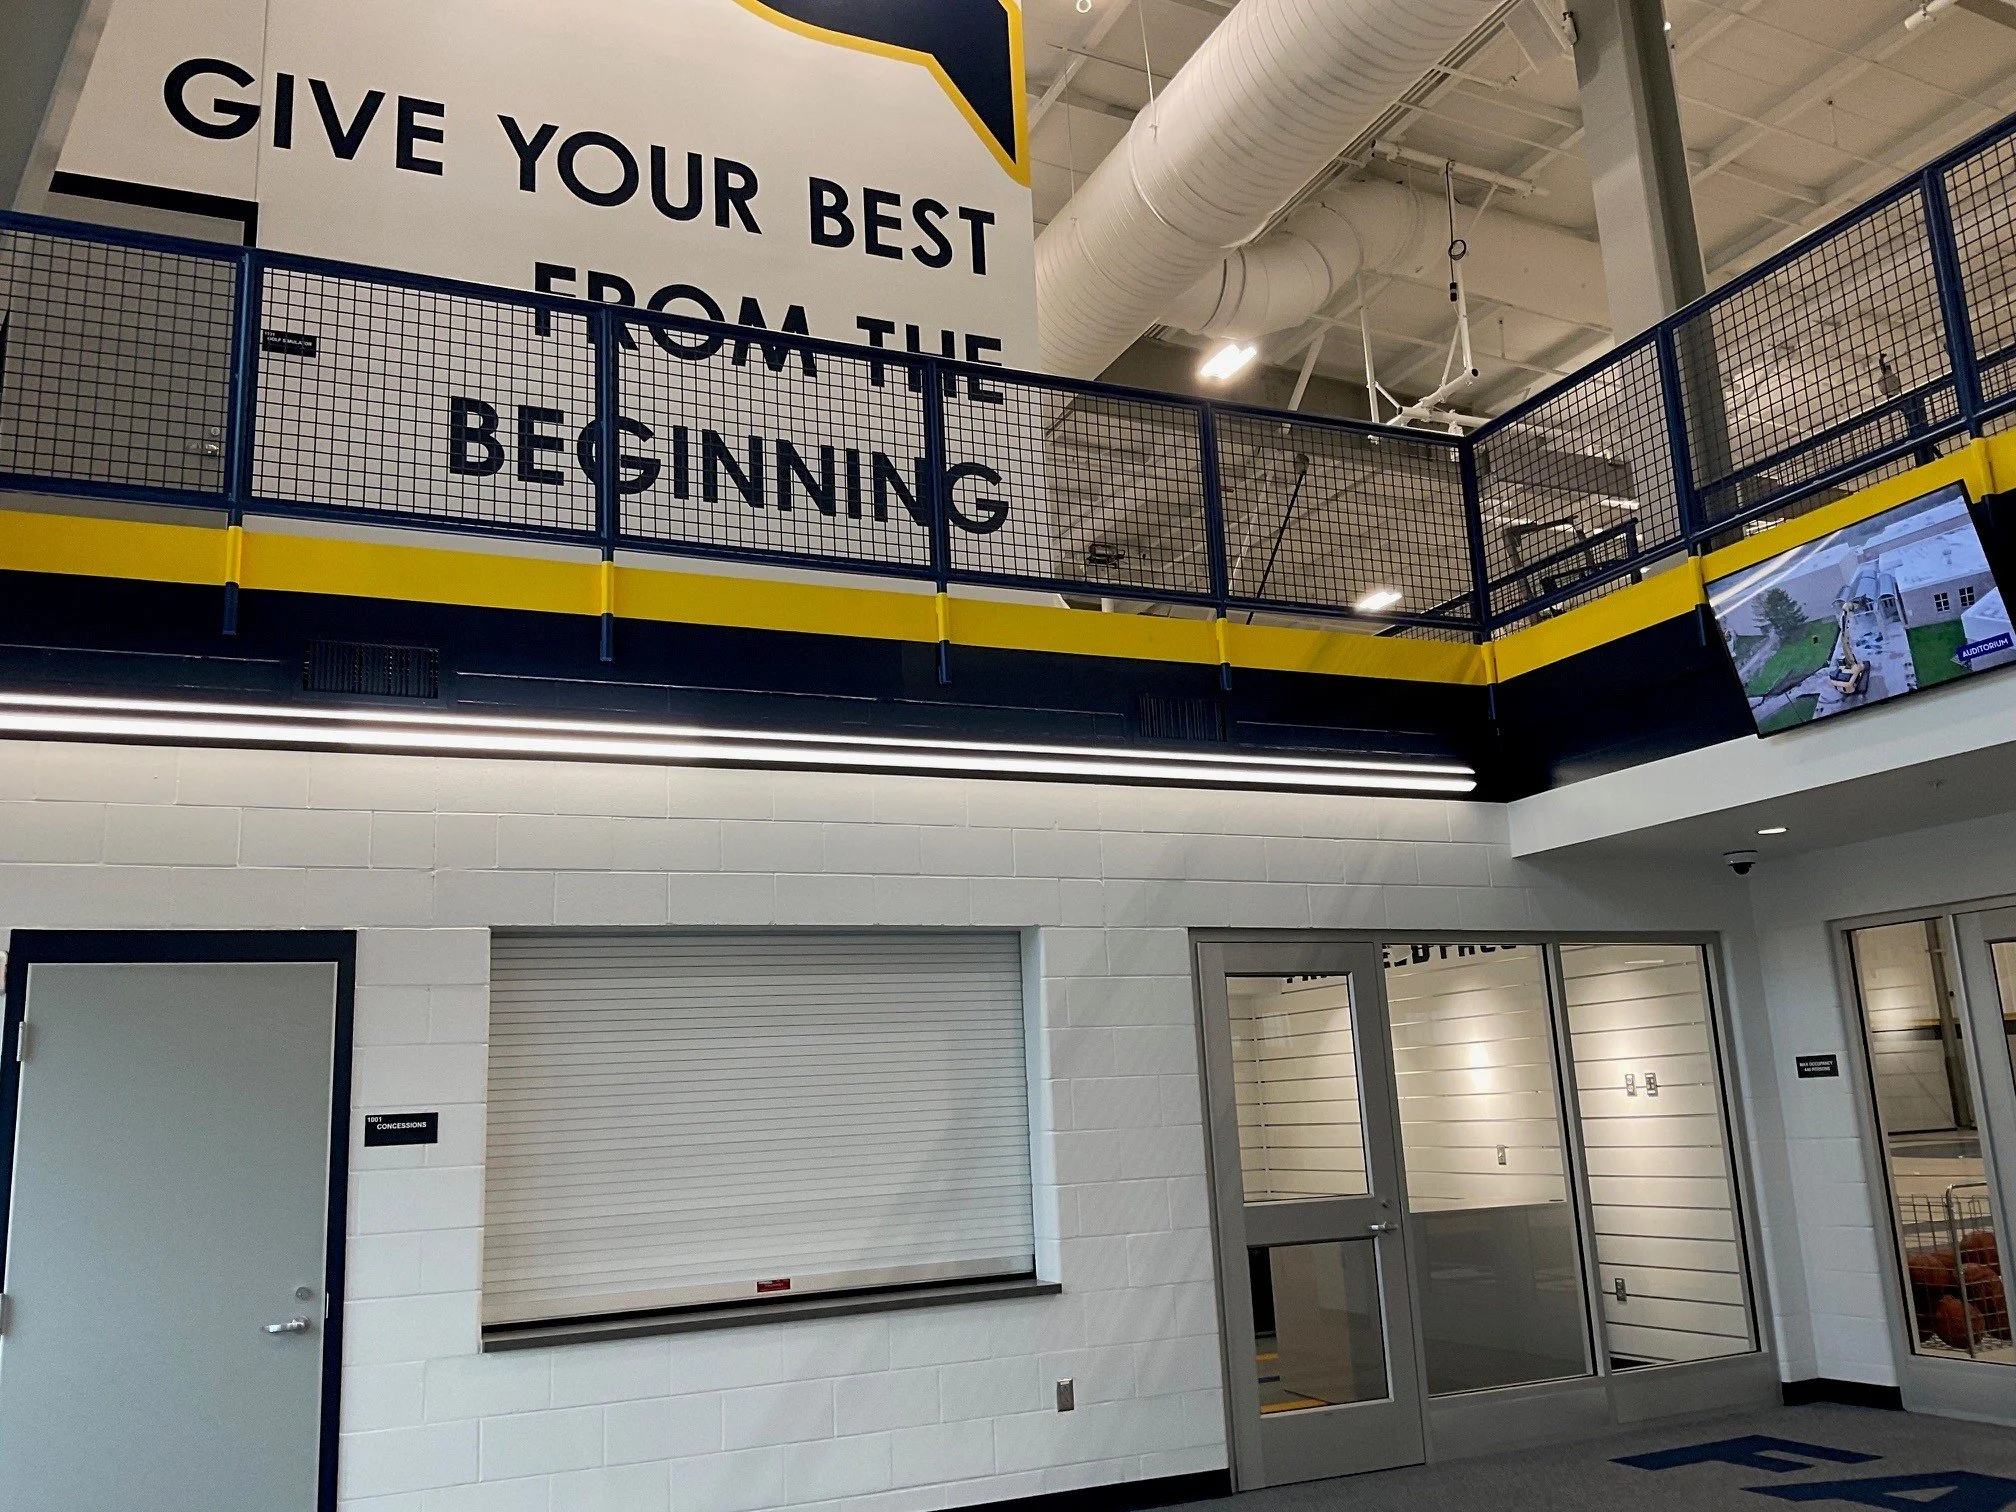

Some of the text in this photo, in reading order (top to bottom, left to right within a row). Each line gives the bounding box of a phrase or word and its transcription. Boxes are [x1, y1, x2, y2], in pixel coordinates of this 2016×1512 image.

[163, 57, 996, 276] GIVE YOUR BEST
[534, 261, 1004, 405] FROM THE
[449, 395, 1010, 535] BEGINNING
[1962, 638, 2009, 658] AUDITORIUM
[376, 1121, 428, 1130] CONCESSIONS
